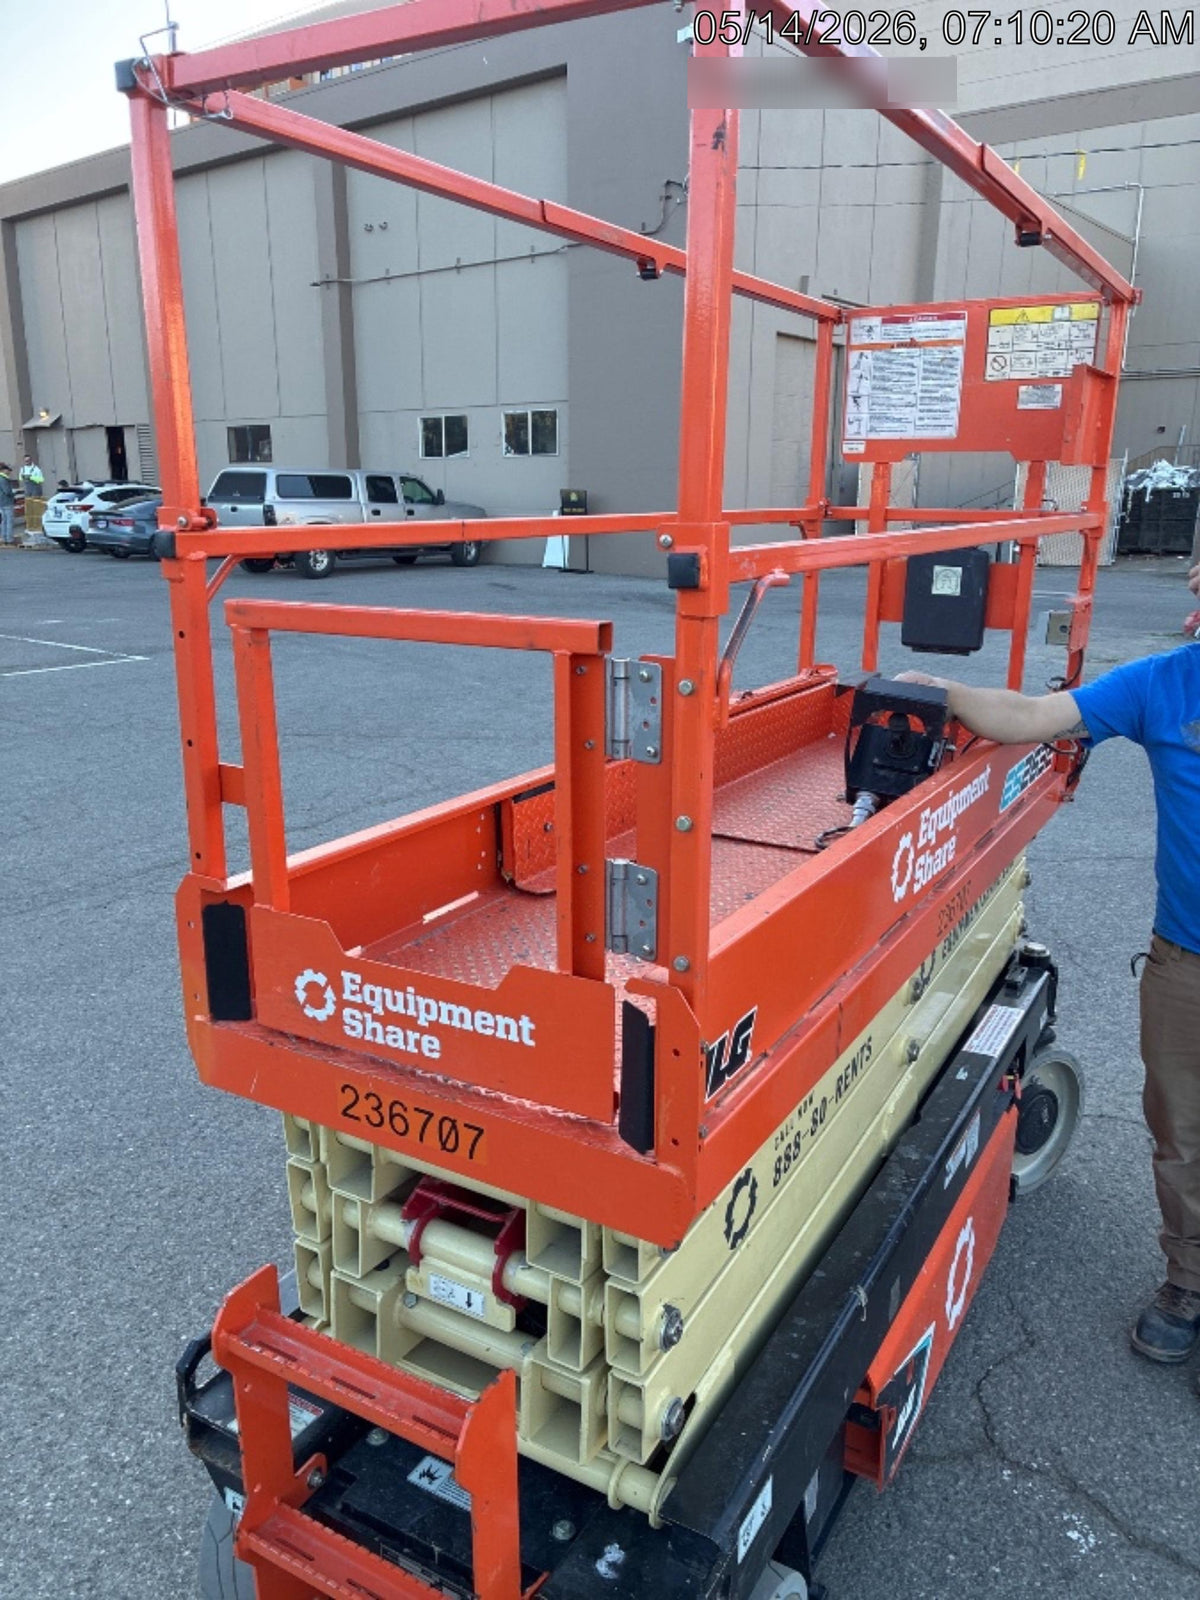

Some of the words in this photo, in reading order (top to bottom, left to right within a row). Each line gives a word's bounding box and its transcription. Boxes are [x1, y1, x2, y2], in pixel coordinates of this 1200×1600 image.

[917, 764, 992, 849] Equipment
[913, 836, 956, 894] Share
[341, 970, 536, 1047] Equipment
[342, 1007, 441, 1059] Share
[340, 1084, 485, 1160] 236707
[773, 1035, 873, 1188] 888-80-RENTS
